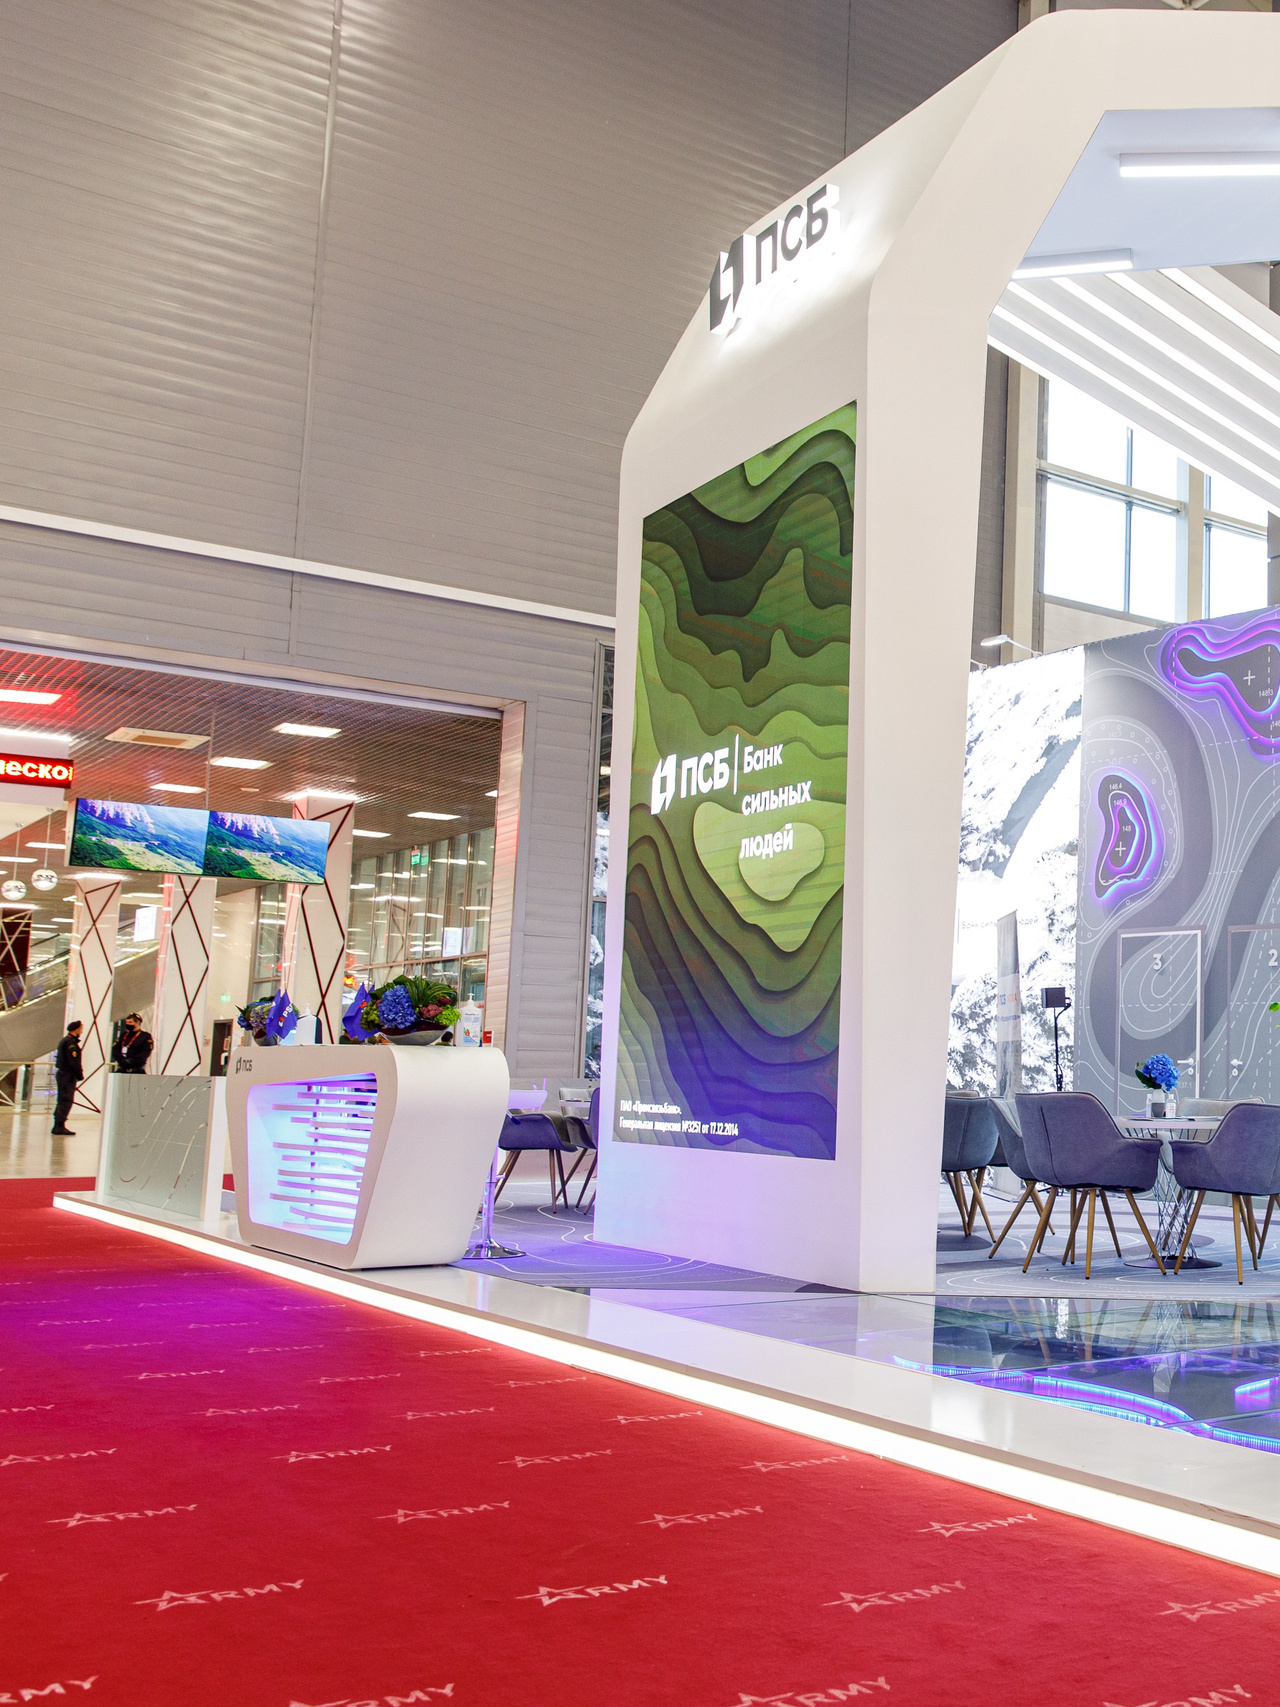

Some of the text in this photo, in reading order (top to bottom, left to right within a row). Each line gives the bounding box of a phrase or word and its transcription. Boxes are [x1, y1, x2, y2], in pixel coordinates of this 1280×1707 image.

[755, 183, 831, 286] ПСБ
[680, 744, 783, 799] ПСБ Банк
[741, 780, 812, 816] сильных
[739, 823, 794, 860] людей
[1153, 954, 1162, 970] 3
[1269, 949, 1278, 966] 2
[702, 1124, 709, 1133] от
